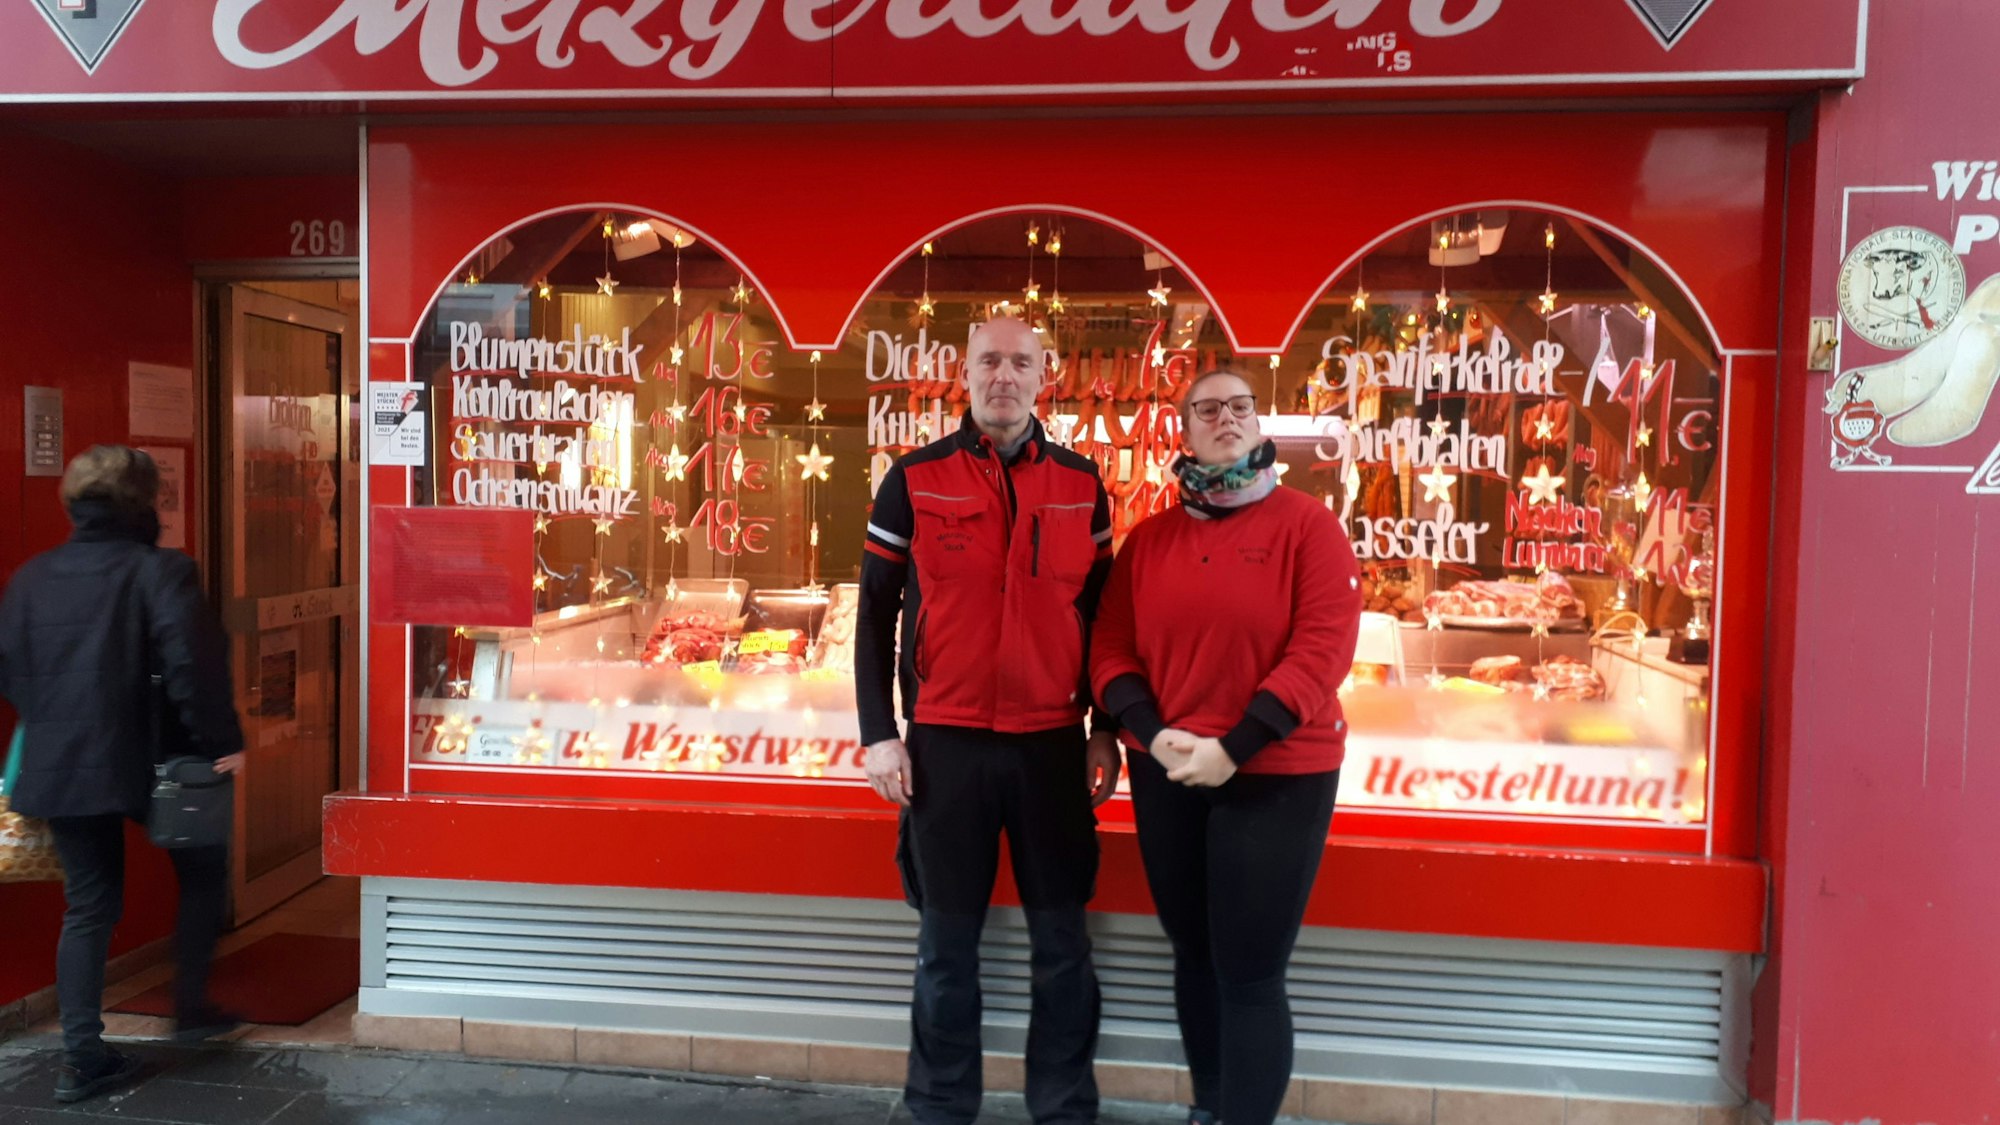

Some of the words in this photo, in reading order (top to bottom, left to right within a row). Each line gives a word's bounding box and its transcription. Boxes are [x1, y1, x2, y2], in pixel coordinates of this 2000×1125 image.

[290, 220, 345, 255] 269
[1953, 214, 2000, 255] P
[451, 321, 645, 383] Blumenstück
[866, 328, 957, 382] Dicke
